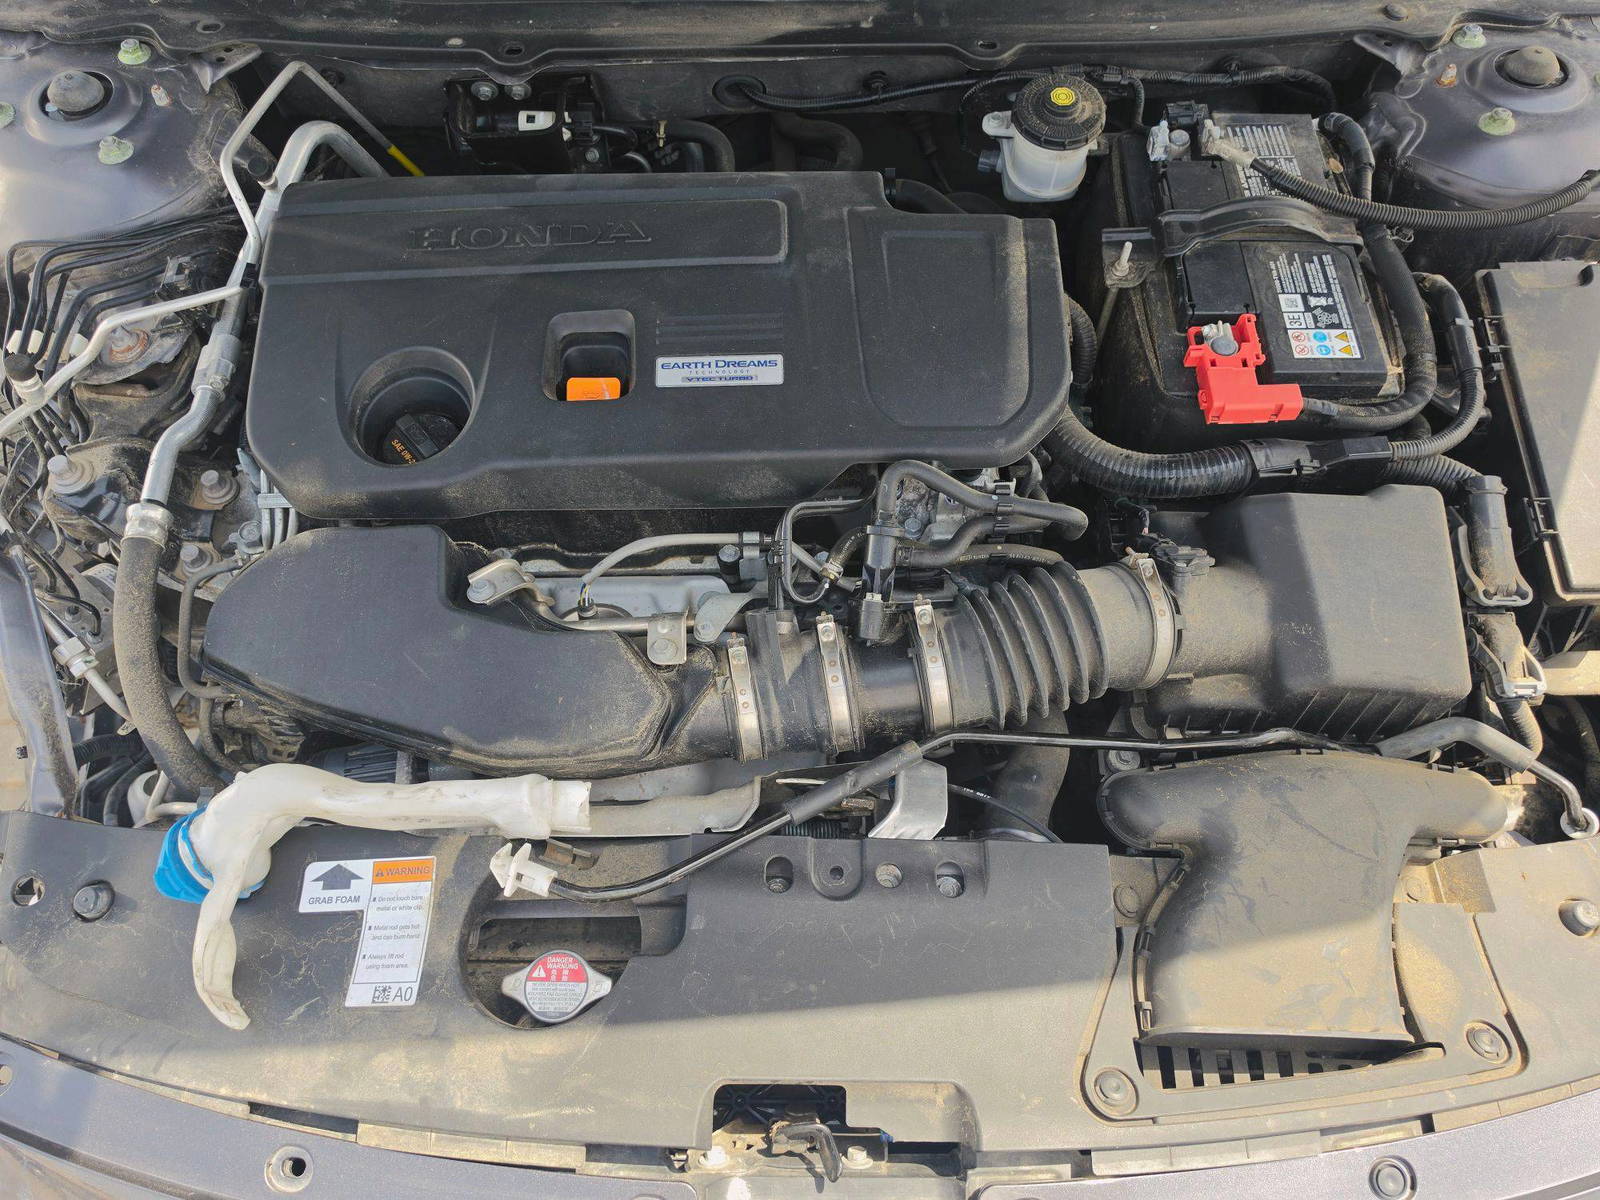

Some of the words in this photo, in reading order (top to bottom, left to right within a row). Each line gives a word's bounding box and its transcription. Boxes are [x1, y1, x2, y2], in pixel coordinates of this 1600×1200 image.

[406, 219, 653, 251] HONDA
[1287, 314, 1303, 327] 3E
[660, 361, 711, 370] EARTH
[391, 439, 405, 453] SAE
[401, 450, 417, 465] 0W-2
[385, 865, 431, 877] WARNING
[308, 895, 334, 905] GRAB
[335, 895, 361, 904] FOAM
